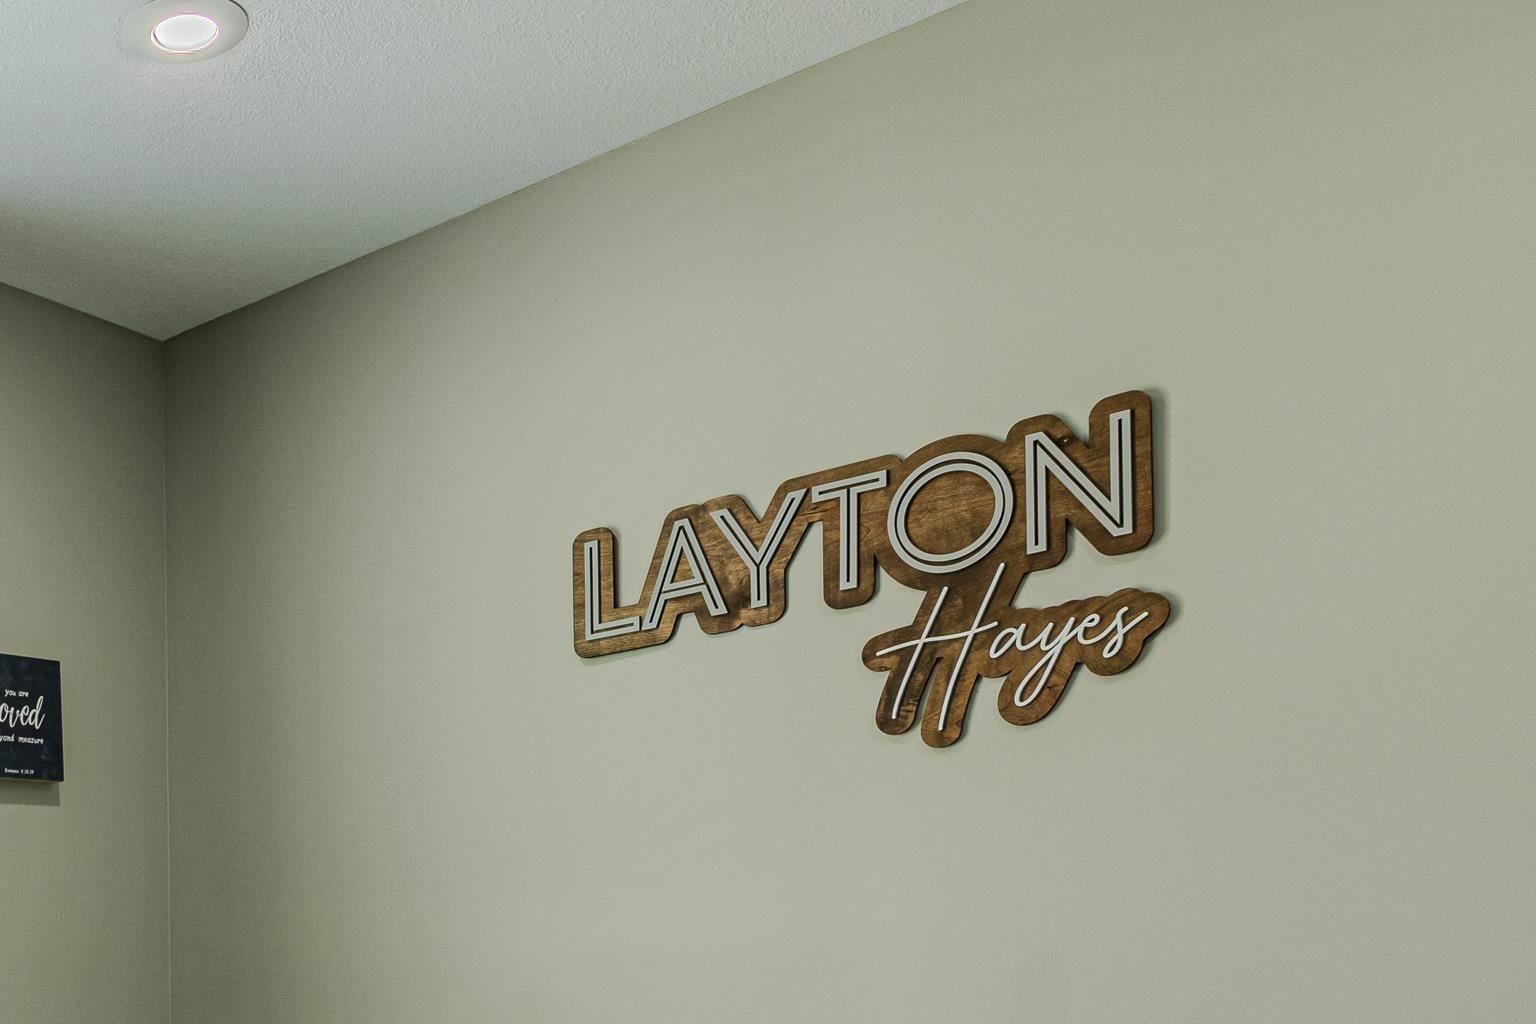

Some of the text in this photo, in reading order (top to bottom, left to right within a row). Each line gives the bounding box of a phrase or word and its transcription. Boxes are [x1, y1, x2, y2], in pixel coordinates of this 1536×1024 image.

[582, 408, 1135, 643] LAYTON
[875, 561, 1149, 733] Hayes
[4, 689, 16, 697] you
[18, 736, 44, 744] measure
